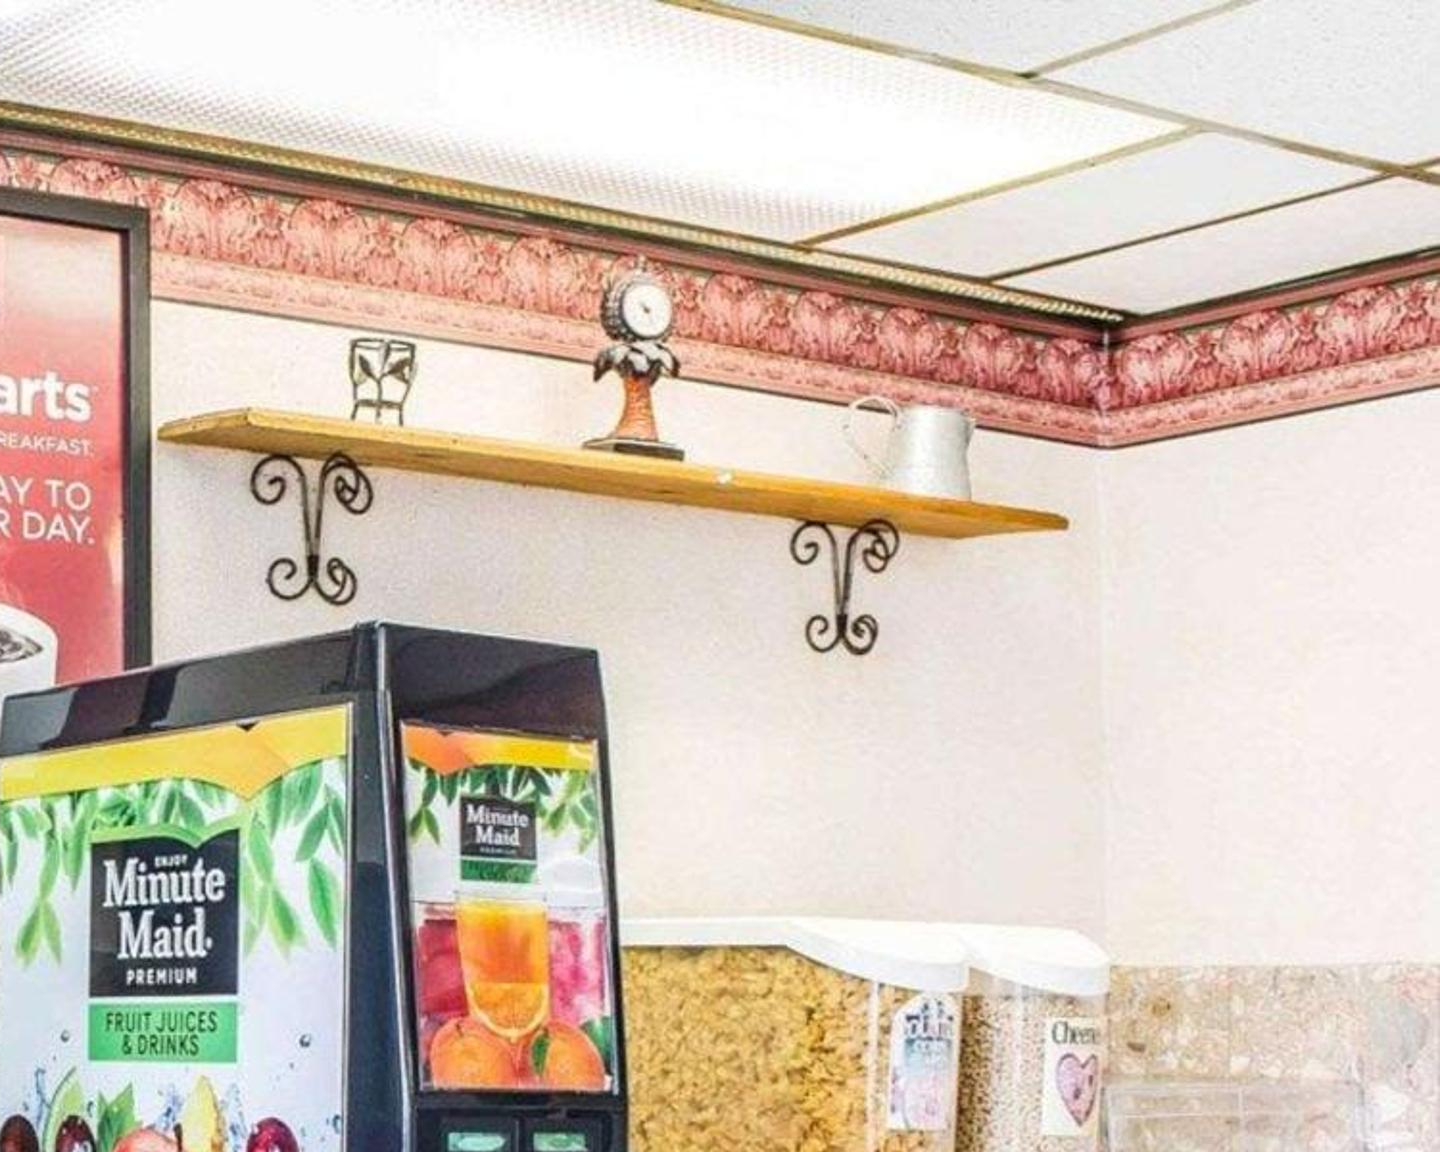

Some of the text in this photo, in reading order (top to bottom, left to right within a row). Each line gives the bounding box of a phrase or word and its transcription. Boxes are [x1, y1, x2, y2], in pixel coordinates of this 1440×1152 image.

[45, 479, 92, 512] TO
[23, 512, 96, 545] DAY.
[466, 803, 529, 828] Minute
[476, 824, 521, 847] Maid
[155, 854, 188, 868] ENJOY
[102, 857, 227, 908] Minute
[117, 906, 208, 961] Maid
[126, 967, 198, 986] PREMIUM
[105, 1010, 218, 1034] FRUIT JUICES
[121, 1033, 200, 1056] & DRINKS
